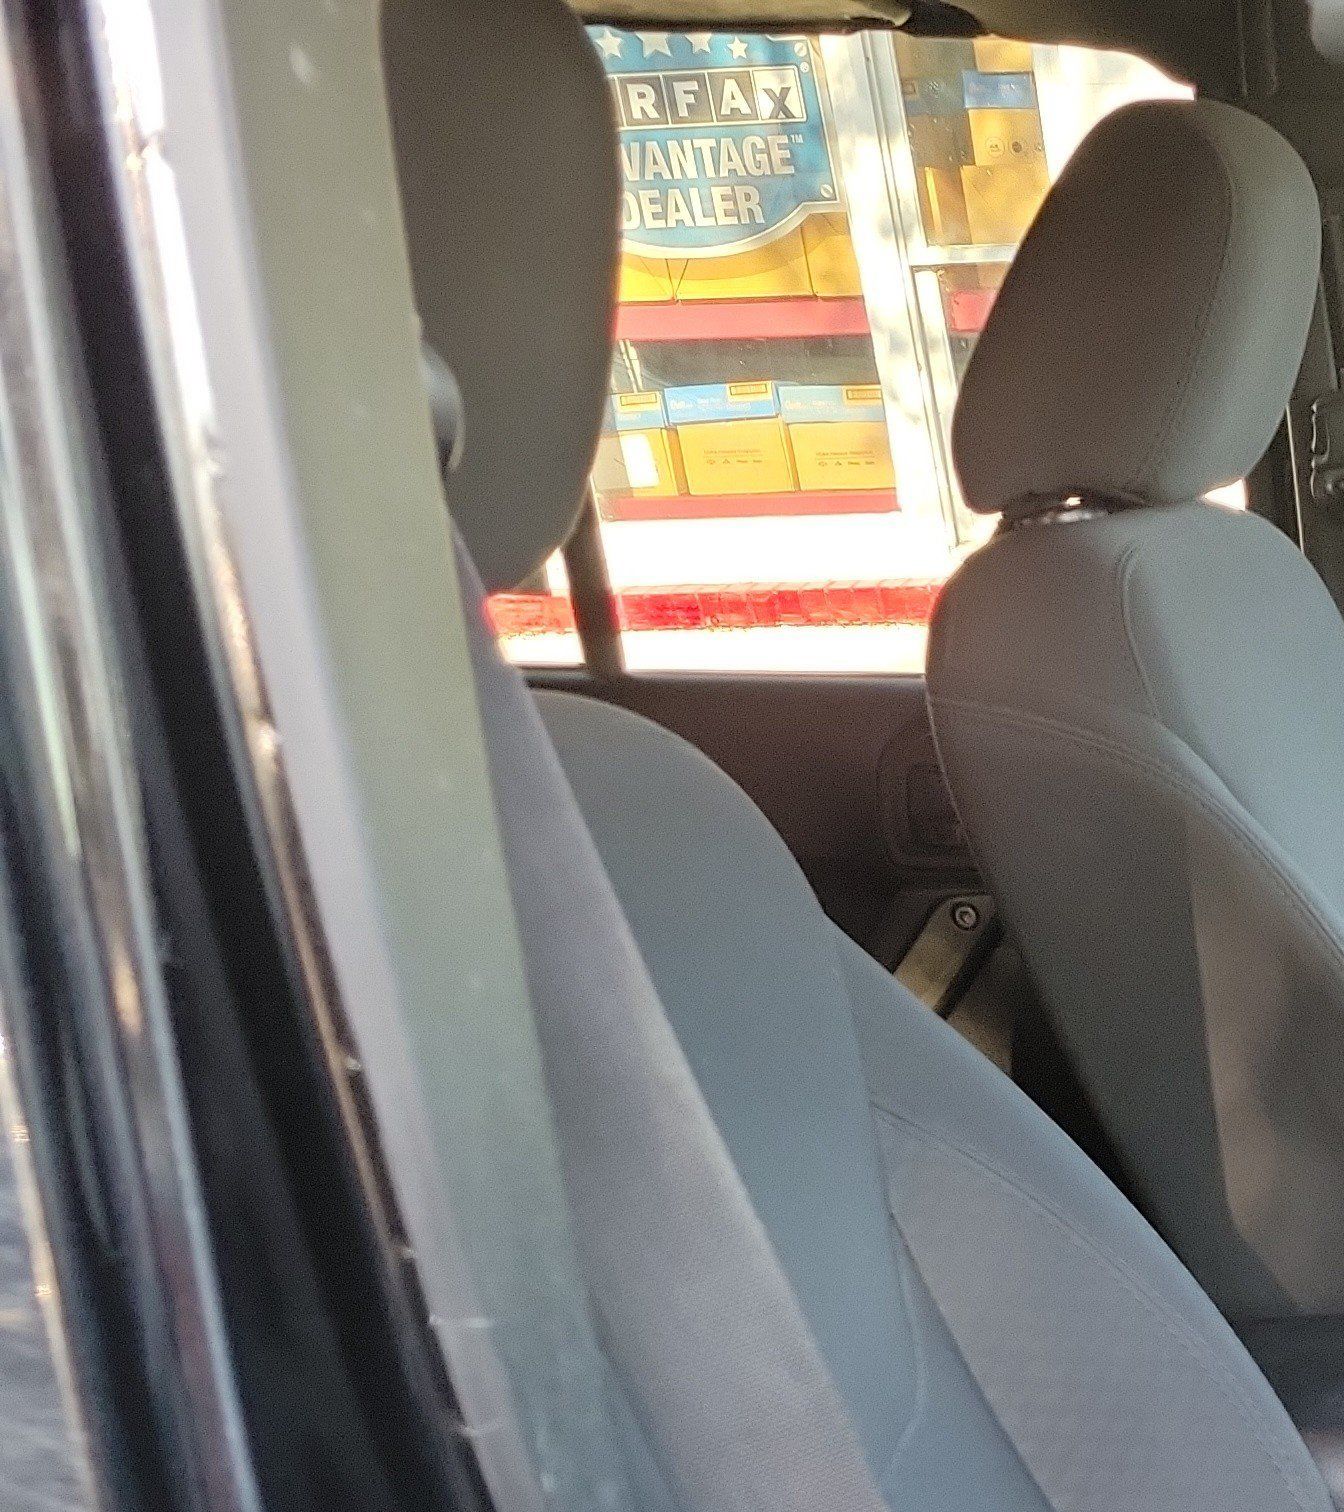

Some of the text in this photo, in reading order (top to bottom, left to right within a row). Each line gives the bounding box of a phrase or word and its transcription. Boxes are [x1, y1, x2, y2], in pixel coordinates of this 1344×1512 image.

[626, 77, 797, 120] RFAX
[620, 134, 795, 182] VANTAGE
[622, 185, 765, 230] DEALER
